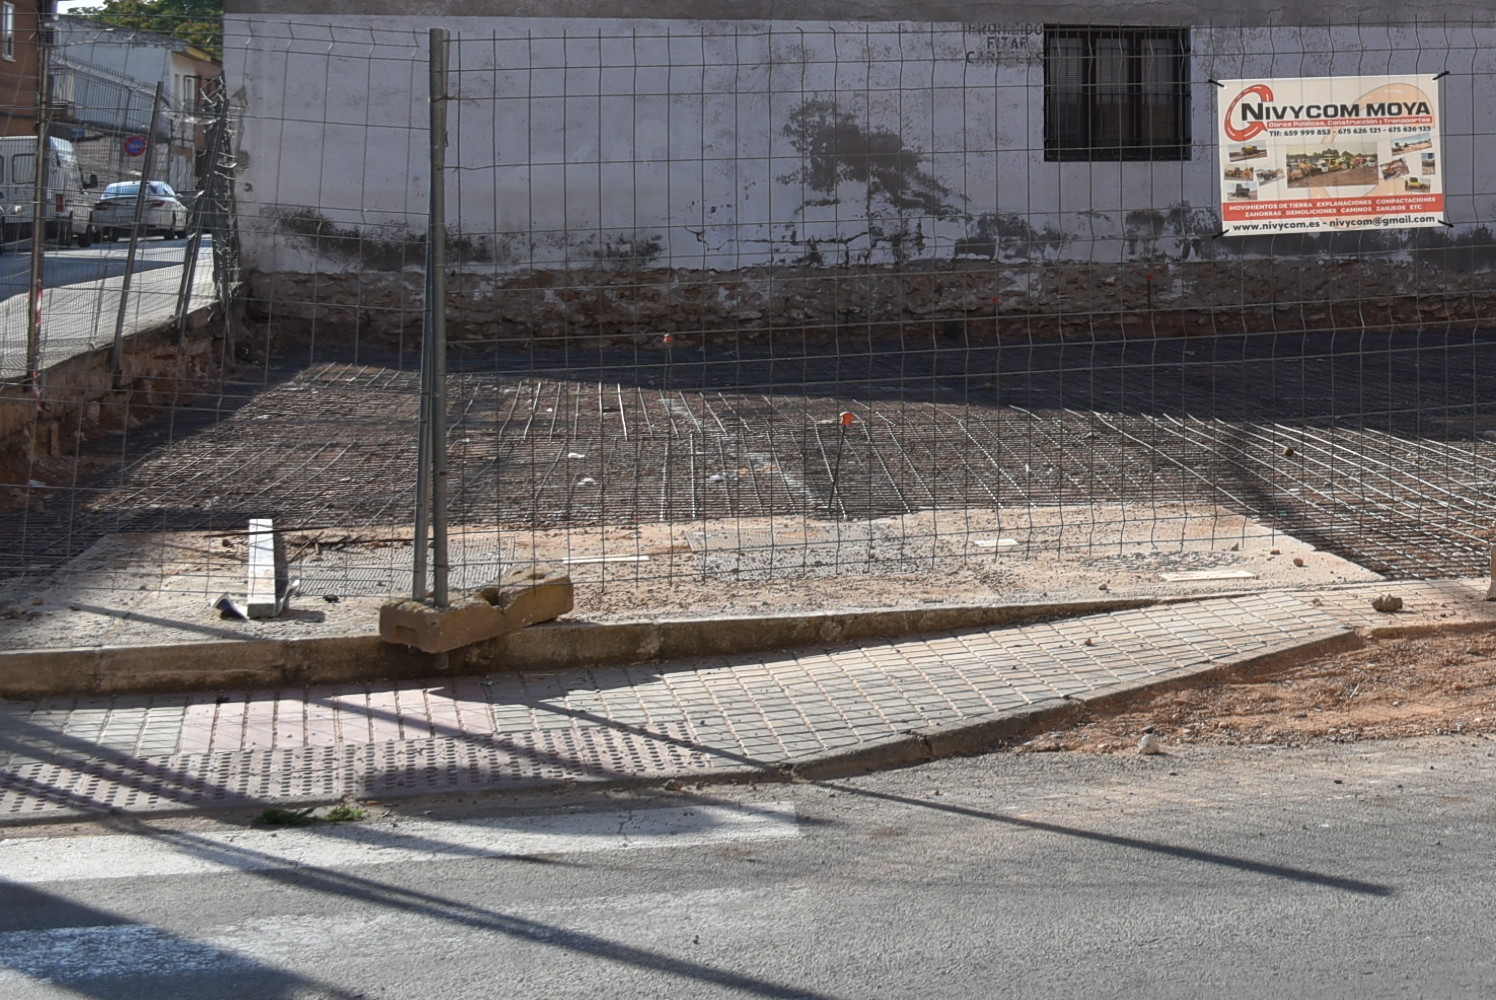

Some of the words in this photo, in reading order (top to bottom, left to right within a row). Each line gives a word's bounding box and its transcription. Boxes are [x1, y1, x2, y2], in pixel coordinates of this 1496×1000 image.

[1241, 103, 1360, 121] NIVYCOM
[1366, 102, 1431, 117] MOYA
[1338, 127, 1352, 135] 675
[1369, 126, 1381, 134] 121
[1403, 125, 1417, 133] 626
[1229, 202, 1278, 210] MOVIMIENTOS
[1288, 201, 1313, 209] TIERRA
[1244, 210, 1282, 218] ZAHORRAS
[1233, 221, 1320, 231] www.nivycom.es
[1329, 215, 1435, 228] nivycom@gmail.com
